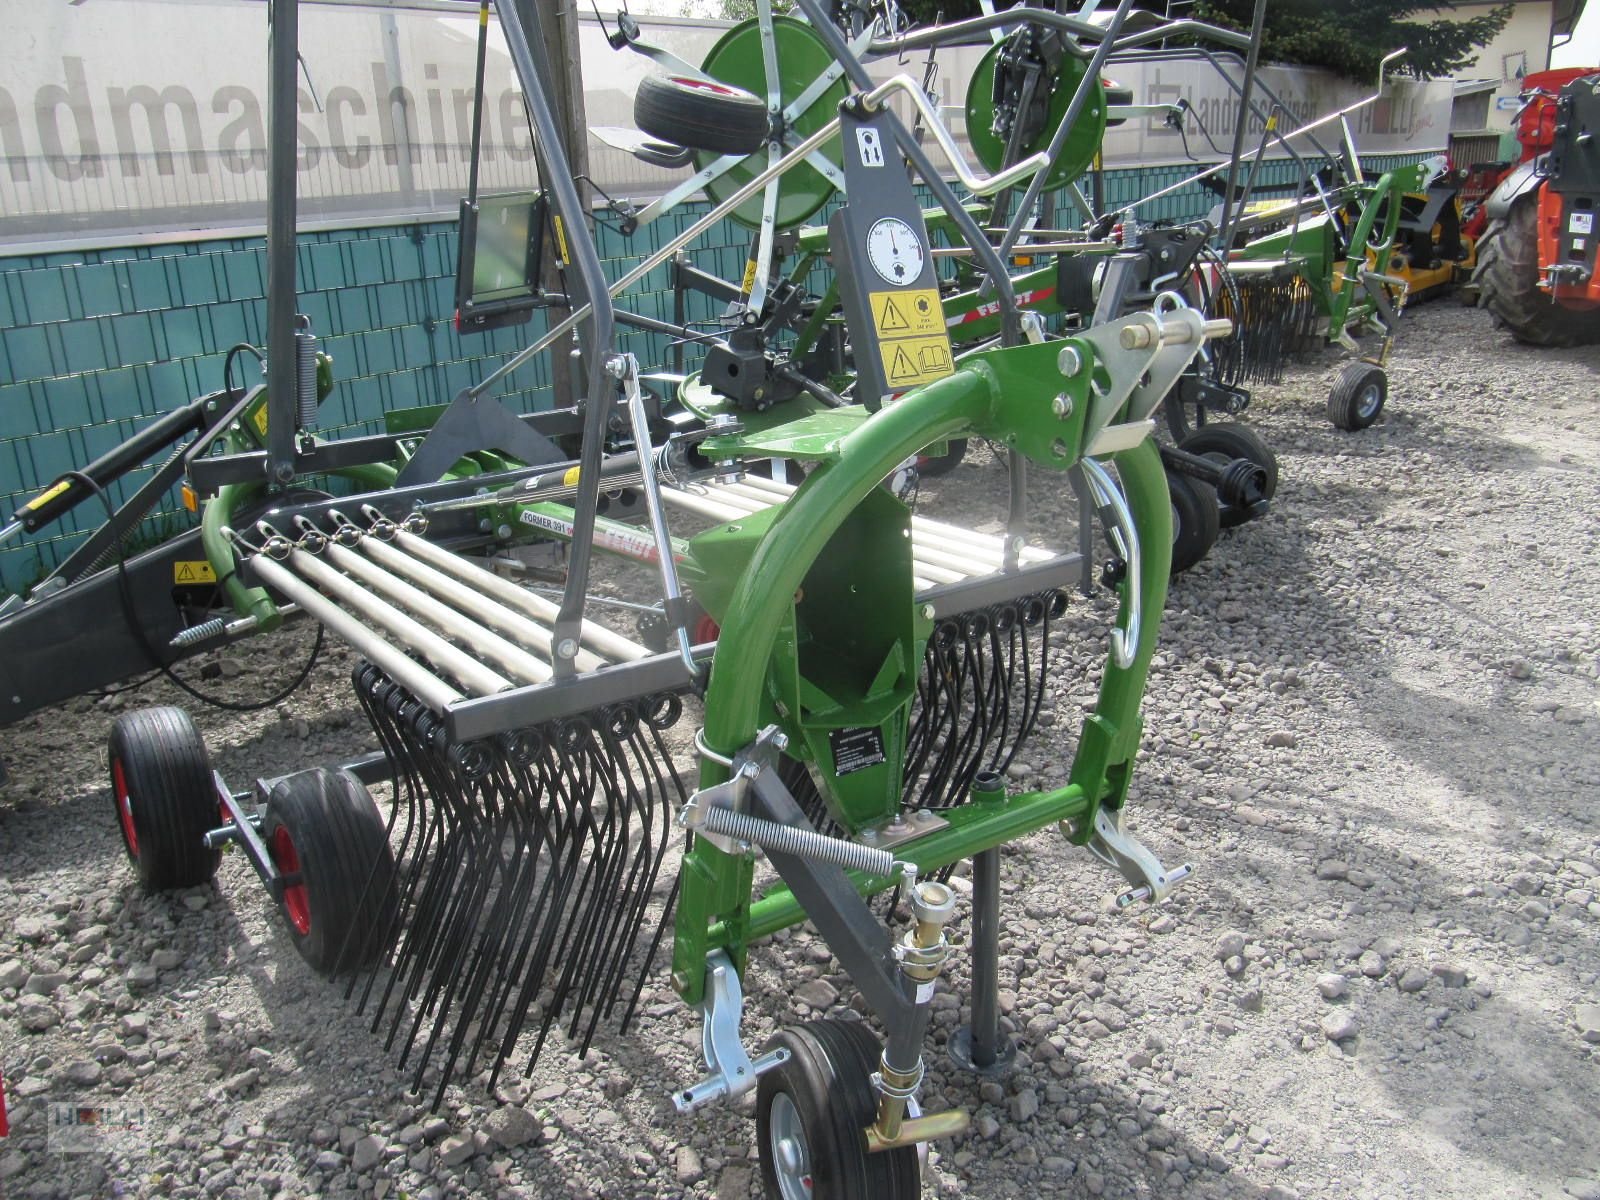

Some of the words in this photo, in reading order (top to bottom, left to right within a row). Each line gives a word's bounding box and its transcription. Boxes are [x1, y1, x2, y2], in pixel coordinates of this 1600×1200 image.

[976, 290, 1033, 317] FEDT
[524, 512, 552, 529] FORMER
[553, 521, 566, 533] 391
